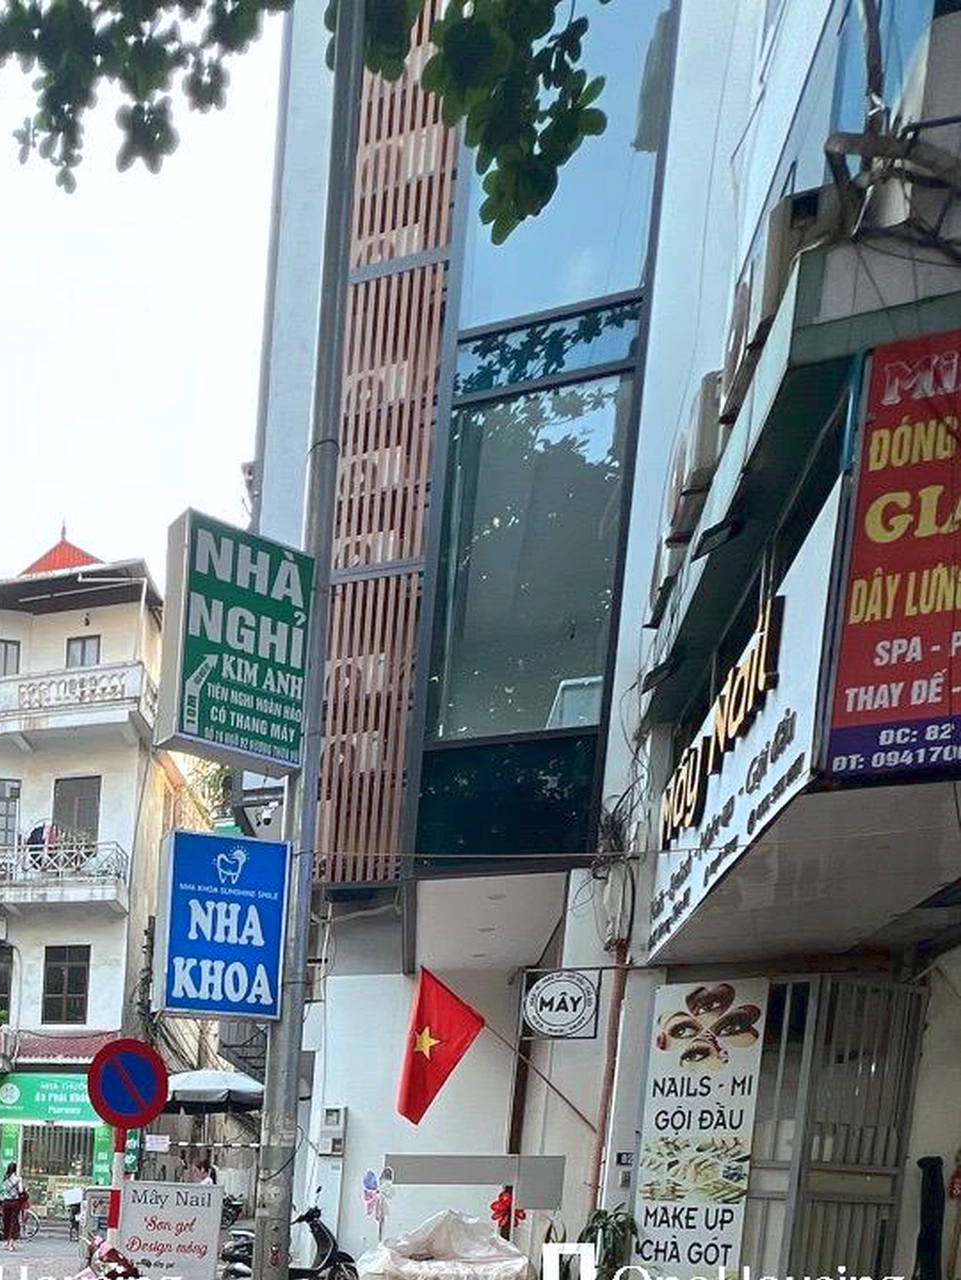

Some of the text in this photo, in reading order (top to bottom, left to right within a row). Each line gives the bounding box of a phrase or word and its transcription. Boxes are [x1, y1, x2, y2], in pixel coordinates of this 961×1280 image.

[868, 415, 959, 472] ĐÓNG
[194, 527, 304, 609] NHÀ
[848, 567, 901, 625] DÂY
[188, 591, 308, 669] NGHỈ
[873, 635, 923, 667] SPA
[221, 653, 259, 687] KIM
[262, 667, 303, 700] ANH
[844, 681, 905, 713] THAY
[910, 667, 948, 706] ĐẾ
[210, 705, 295, 743] CÓ THANG MÁY
[878, 726, 918, 747] ĐC:
[832, 744, 961, 773] ĐT: 094170
[188, 899, 265, 947] NHA
[171, 956, 274, 1005] KHOA
[539, 991, 583, 1013] MÂY
[652, 1075, 712, 1098] NAILS
[730, 1075, 753, 1097] MI
[654, 1101, 745, 1136] GỘI ĐẦU
[131, 1189, 212, 1209] Mây Nail
[643, 1205, 735, 1231] MAKE UP
[639, 1235, 733, 1267] CHÀ GÓT
